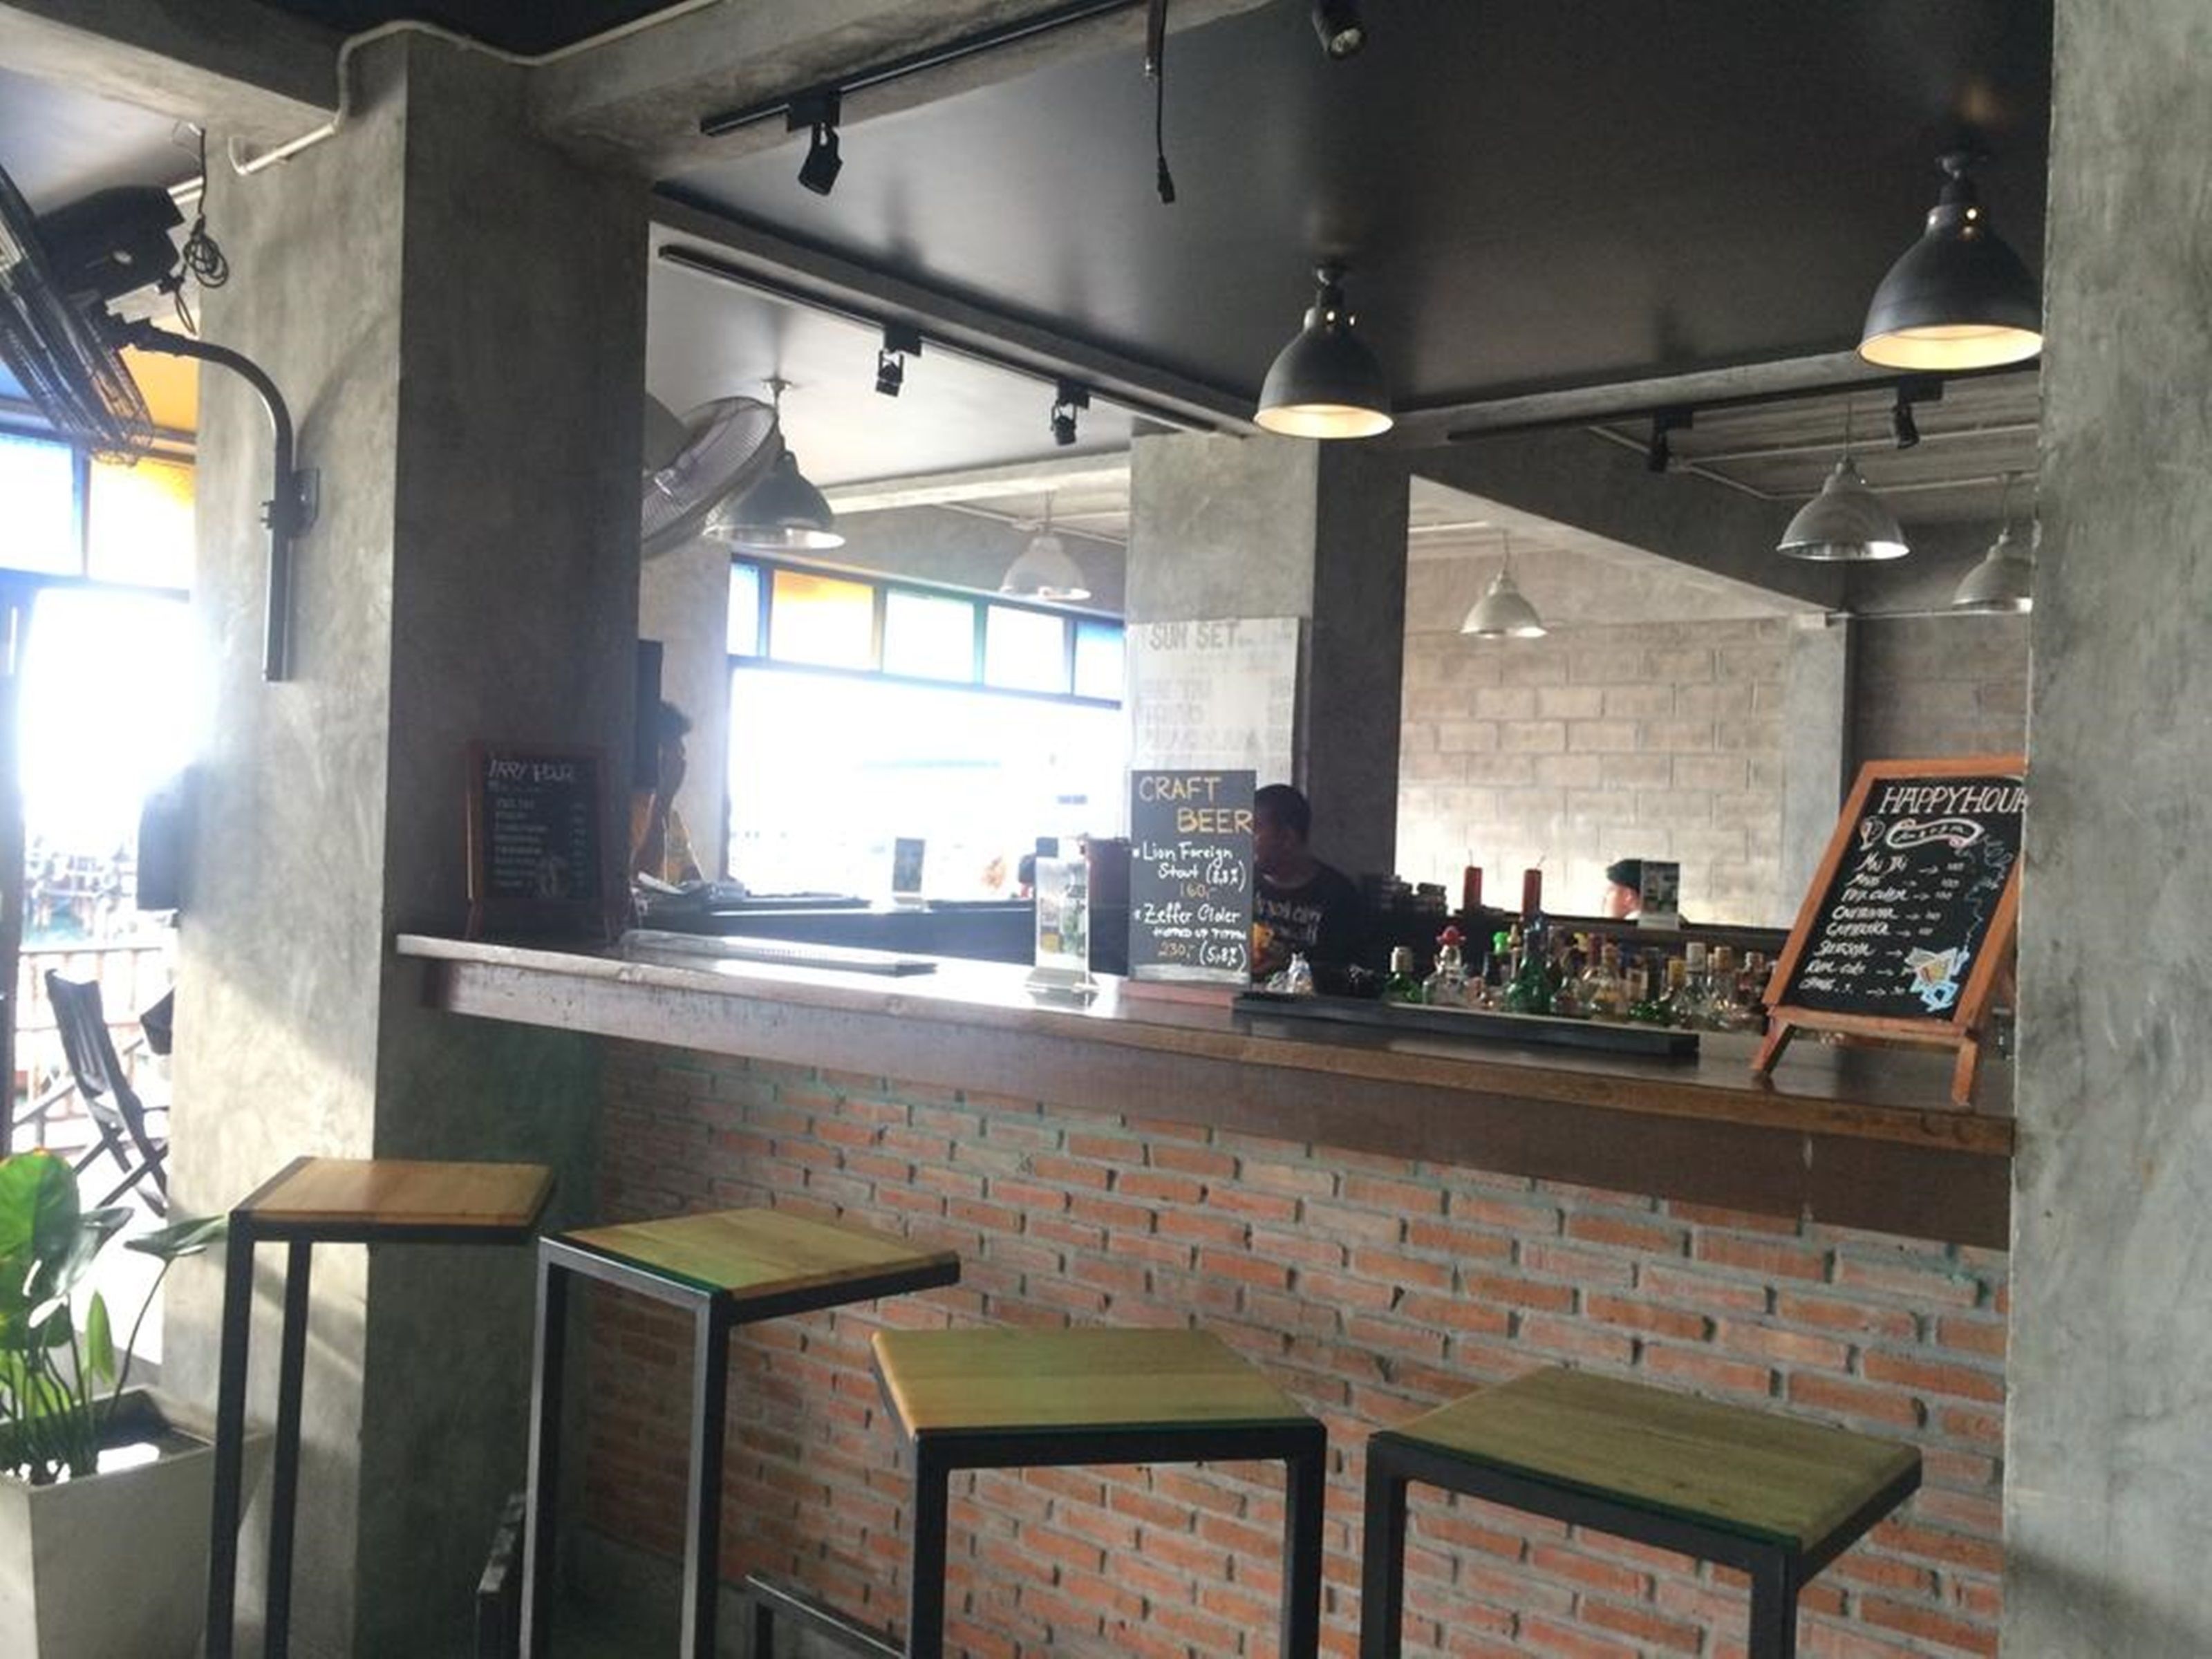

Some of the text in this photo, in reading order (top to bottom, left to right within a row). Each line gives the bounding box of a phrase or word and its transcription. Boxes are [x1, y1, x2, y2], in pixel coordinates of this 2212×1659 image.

[1139, 776, 1221, 802] CRAFT
[1177, 807, 1254, 834] BEER
[1143, 841, 1232, 869] Lion Foreign
[1158, 862, 1199, 879] Stout
[1143, 902, 1193, 924] Zeffer
